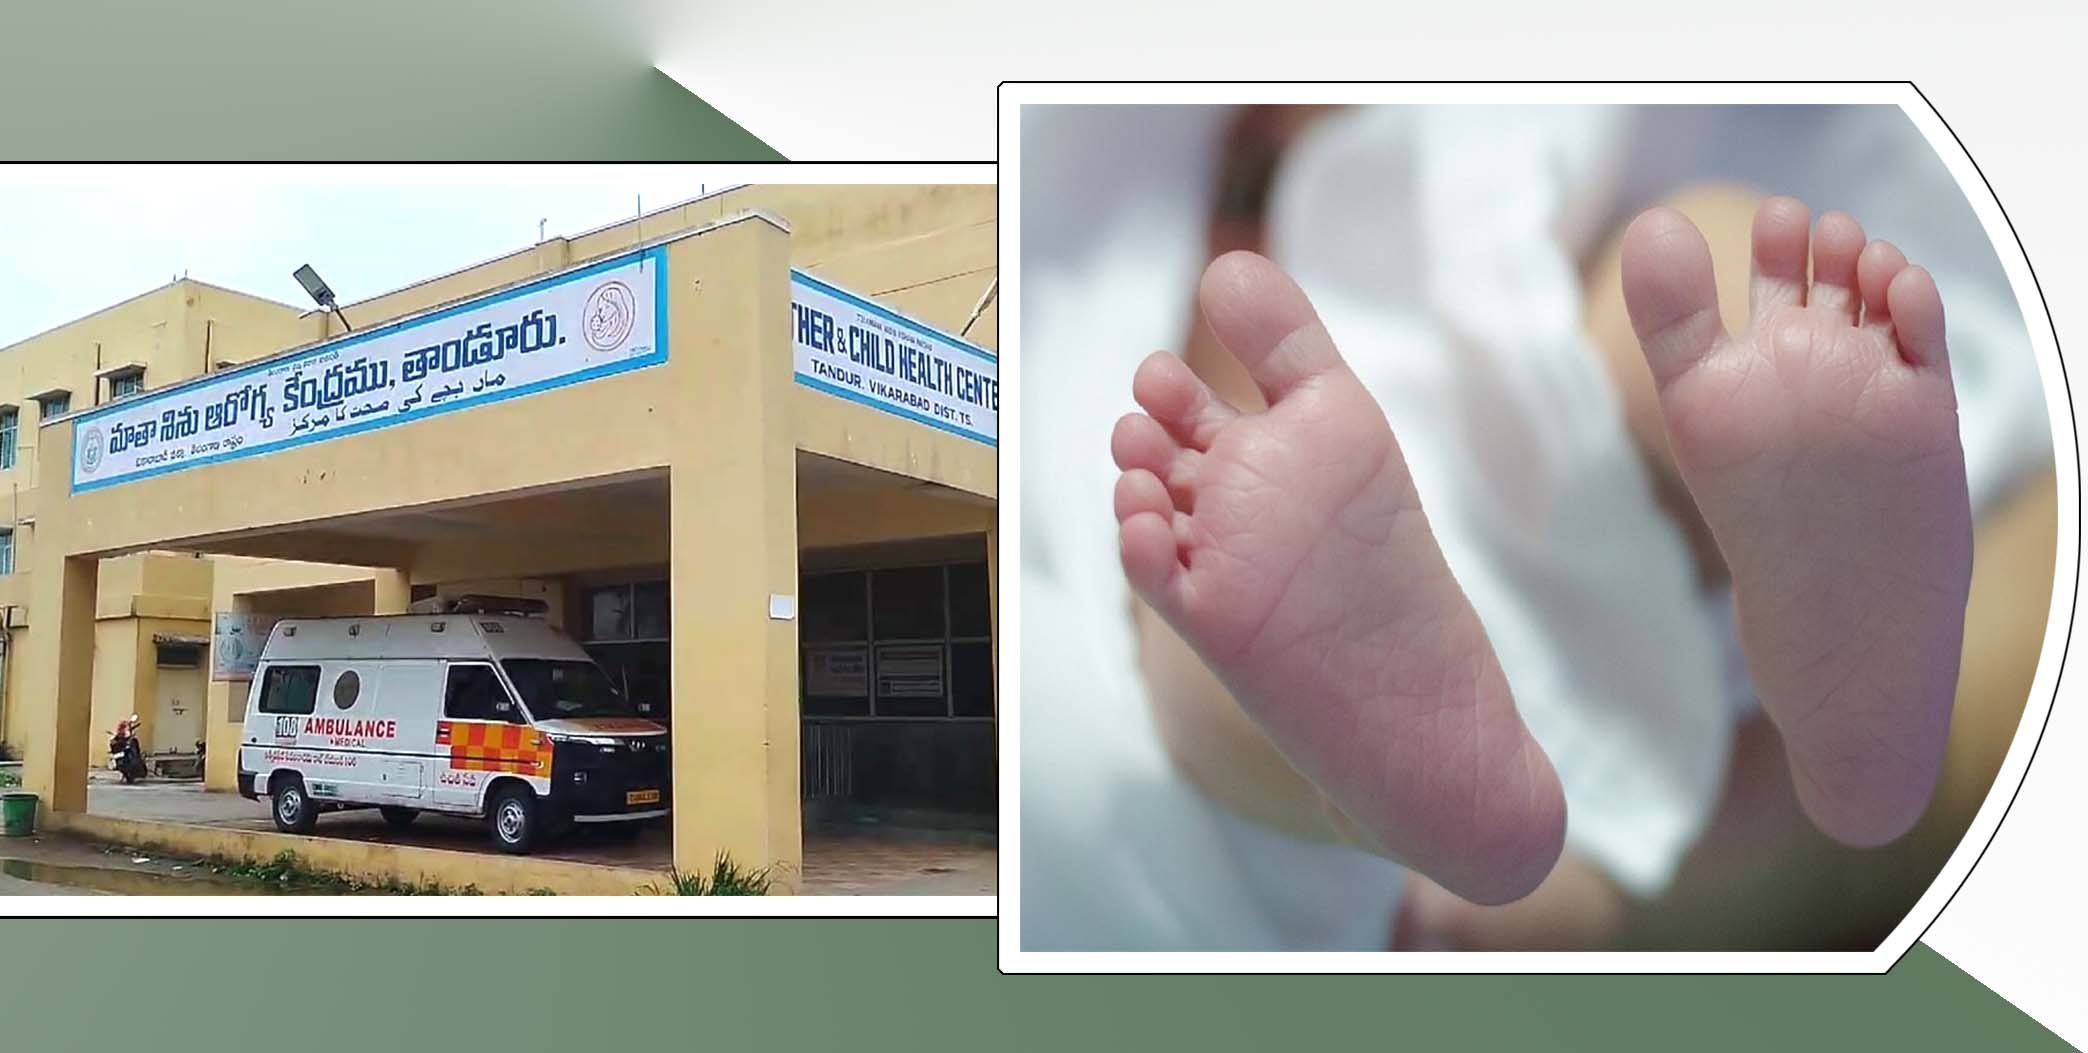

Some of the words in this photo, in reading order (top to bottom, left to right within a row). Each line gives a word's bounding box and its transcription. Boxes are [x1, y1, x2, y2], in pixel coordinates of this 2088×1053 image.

[837, 327, 848, 354] &
[849, 325, 895, 376] CHILD
[899, 343, 953, 396] HEALTH
[869, 379, 930, 412] VIKARABAD
[109, 420, 157, 454] మాతా
[276, 716, 297, 738] 108
[304, 717, 397, 738] AMBULANCE
